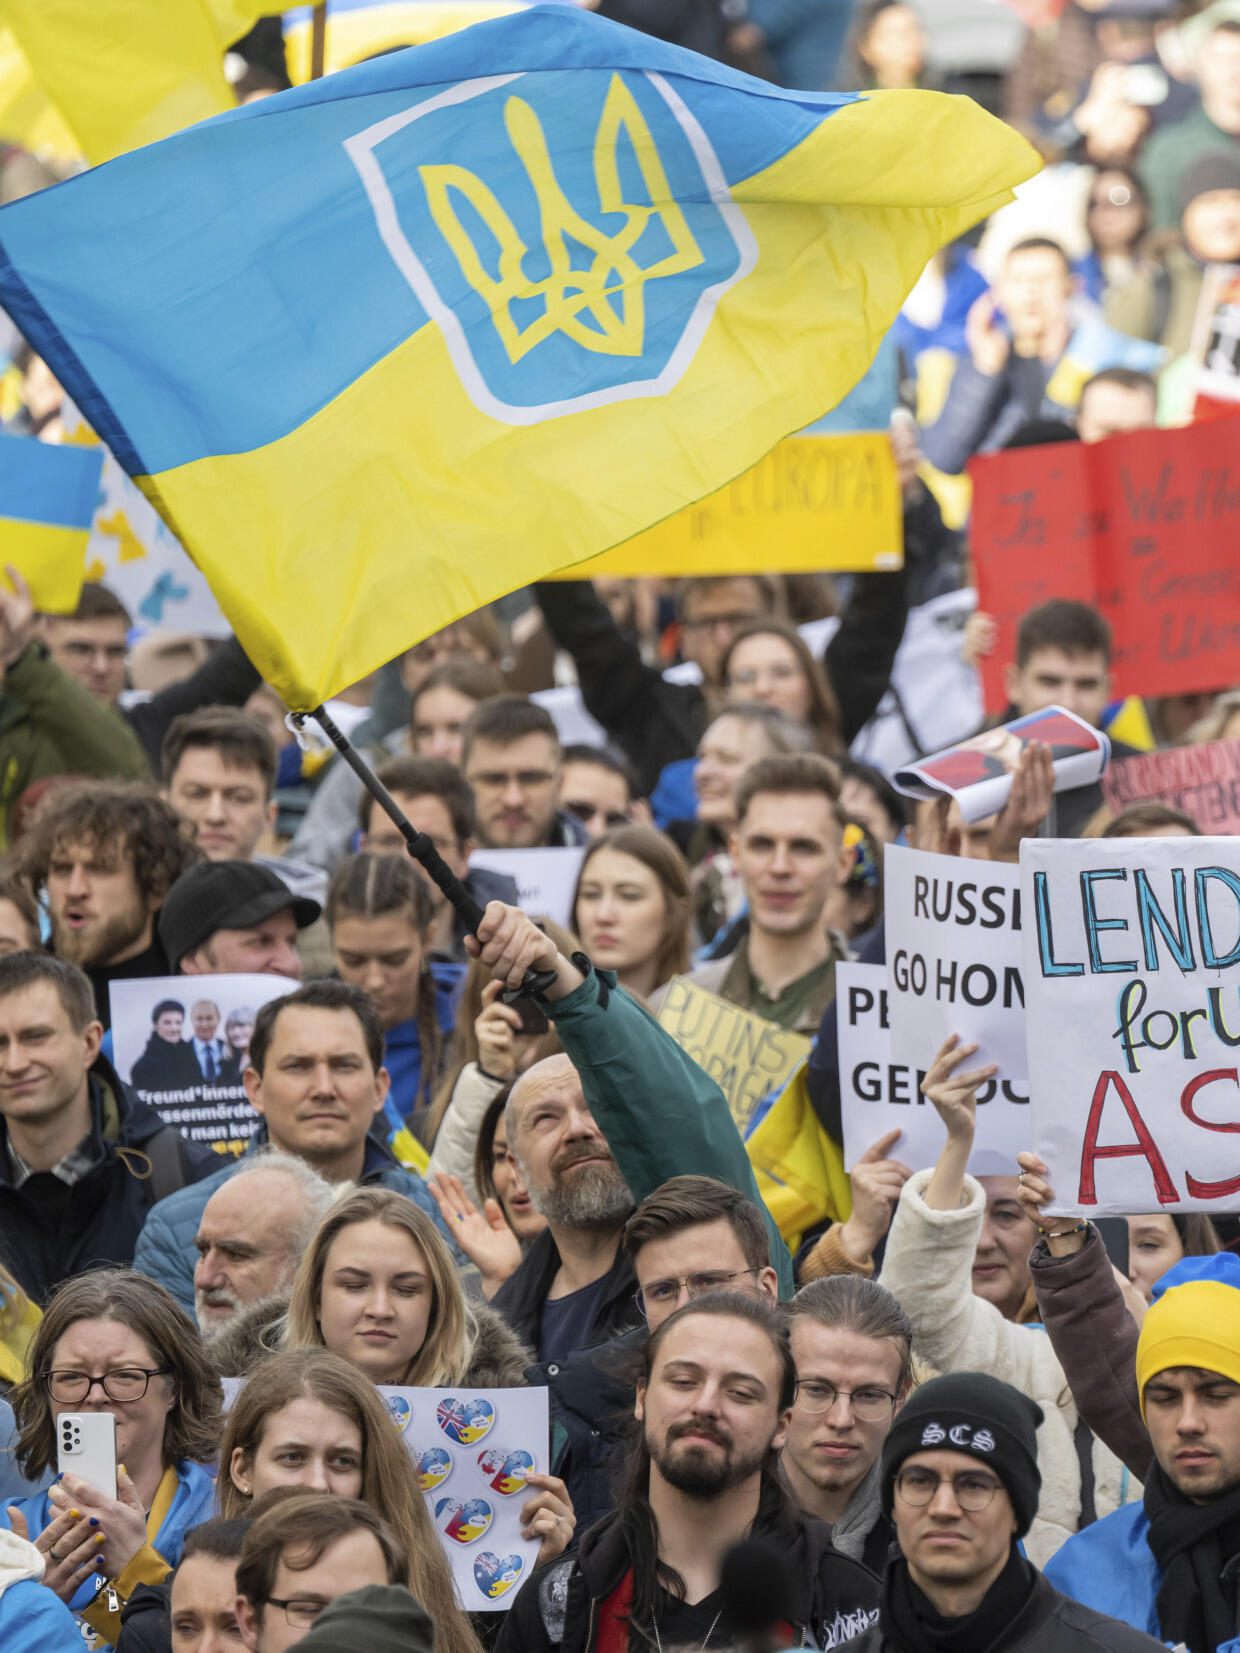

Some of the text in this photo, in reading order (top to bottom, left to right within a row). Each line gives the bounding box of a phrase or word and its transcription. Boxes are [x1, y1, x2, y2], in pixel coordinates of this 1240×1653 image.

[894, 949, 928, 996] GO
[656, 978, 788, 1074] PUTINS
[1112, 978, 1207, 1073] for
[191, 1125, 228, 1140] man
